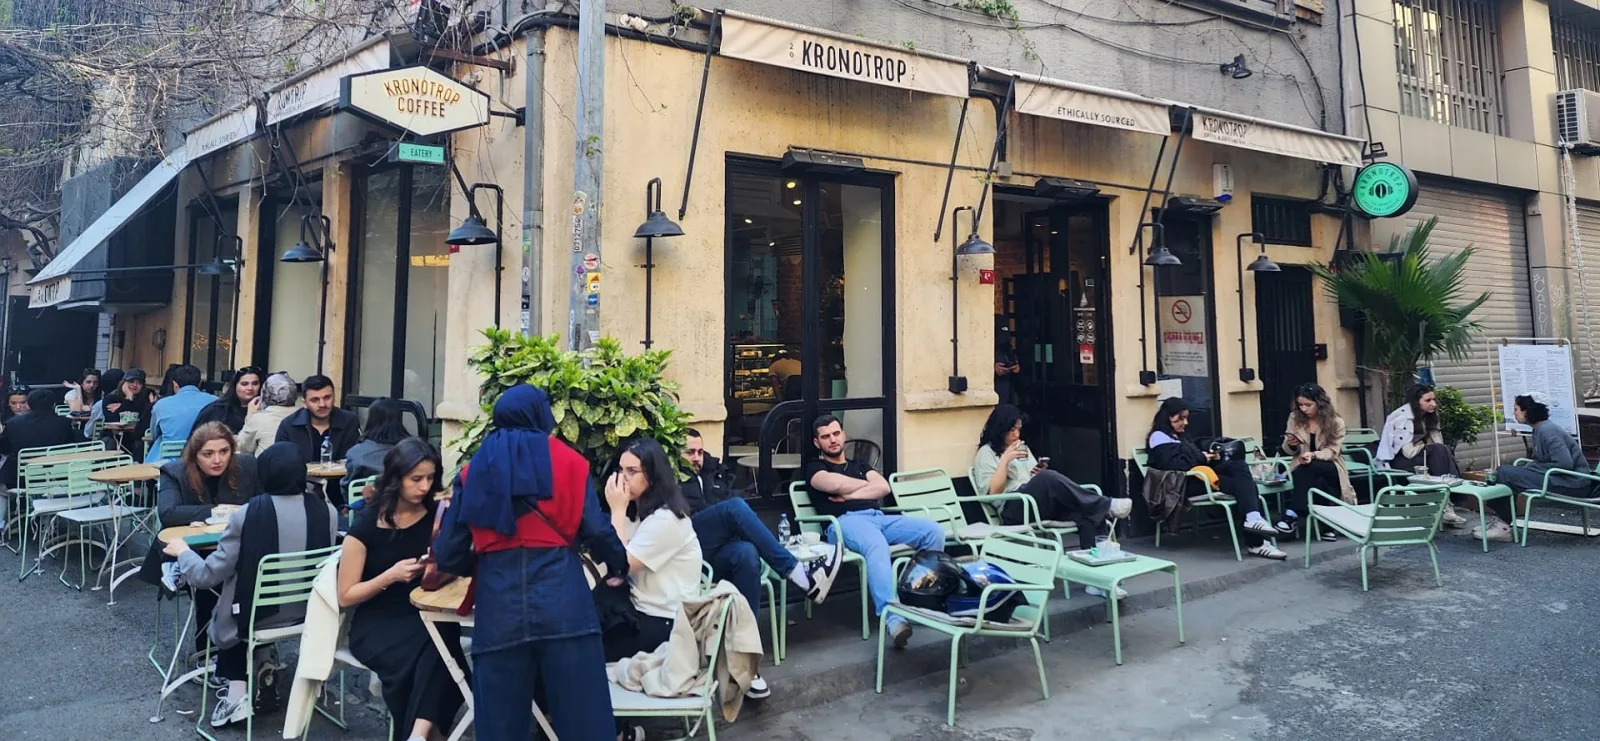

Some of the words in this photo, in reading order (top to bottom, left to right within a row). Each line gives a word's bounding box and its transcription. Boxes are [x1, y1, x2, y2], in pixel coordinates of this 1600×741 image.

[802, 40, 907, 83] KRONOTROP
[383, 78, 460, 105] KRONOTROP
[397, 97, 446, 118] COFFEE
[1057, 106, 1099, 121] ETHICALLY
[1101, 114, 1136, 127] SOURCED
[410, 148, 433, 158] EATERY
